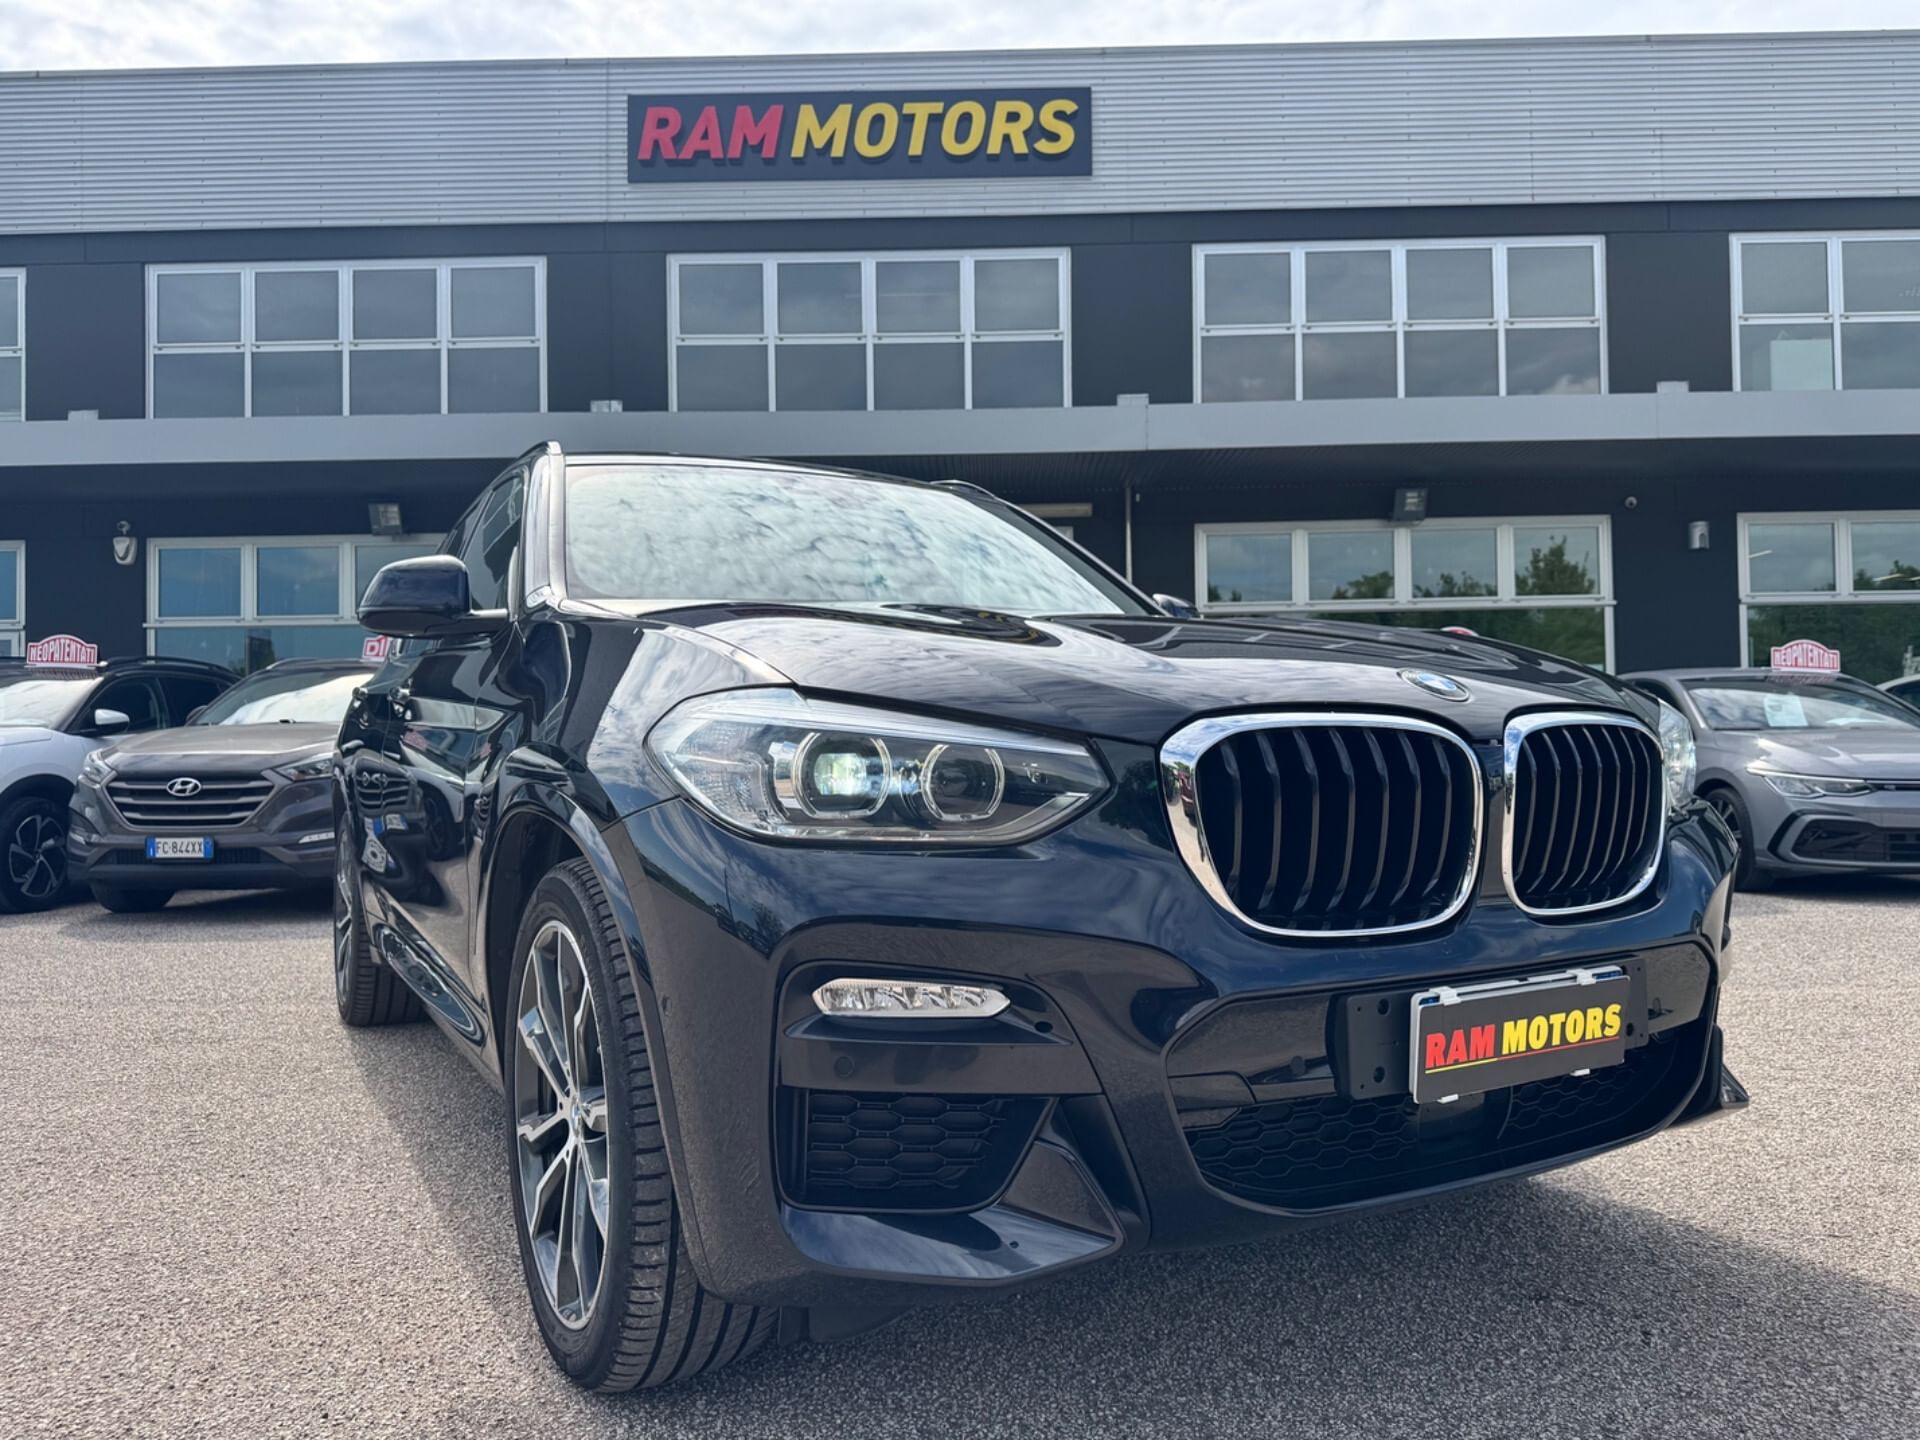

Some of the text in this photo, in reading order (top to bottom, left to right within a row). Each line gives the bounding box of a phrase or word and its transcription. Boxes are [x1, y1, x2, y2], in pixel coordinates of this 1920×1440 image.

[637, 98, 1079, 161] RAM MOTORS
[30, 638, 95, 662] NEOPATENTATI
[1774, 643, 1838, 669] NEOPATENTATI
[1425, 1002, 1623, 1070] RAM MOTORS
